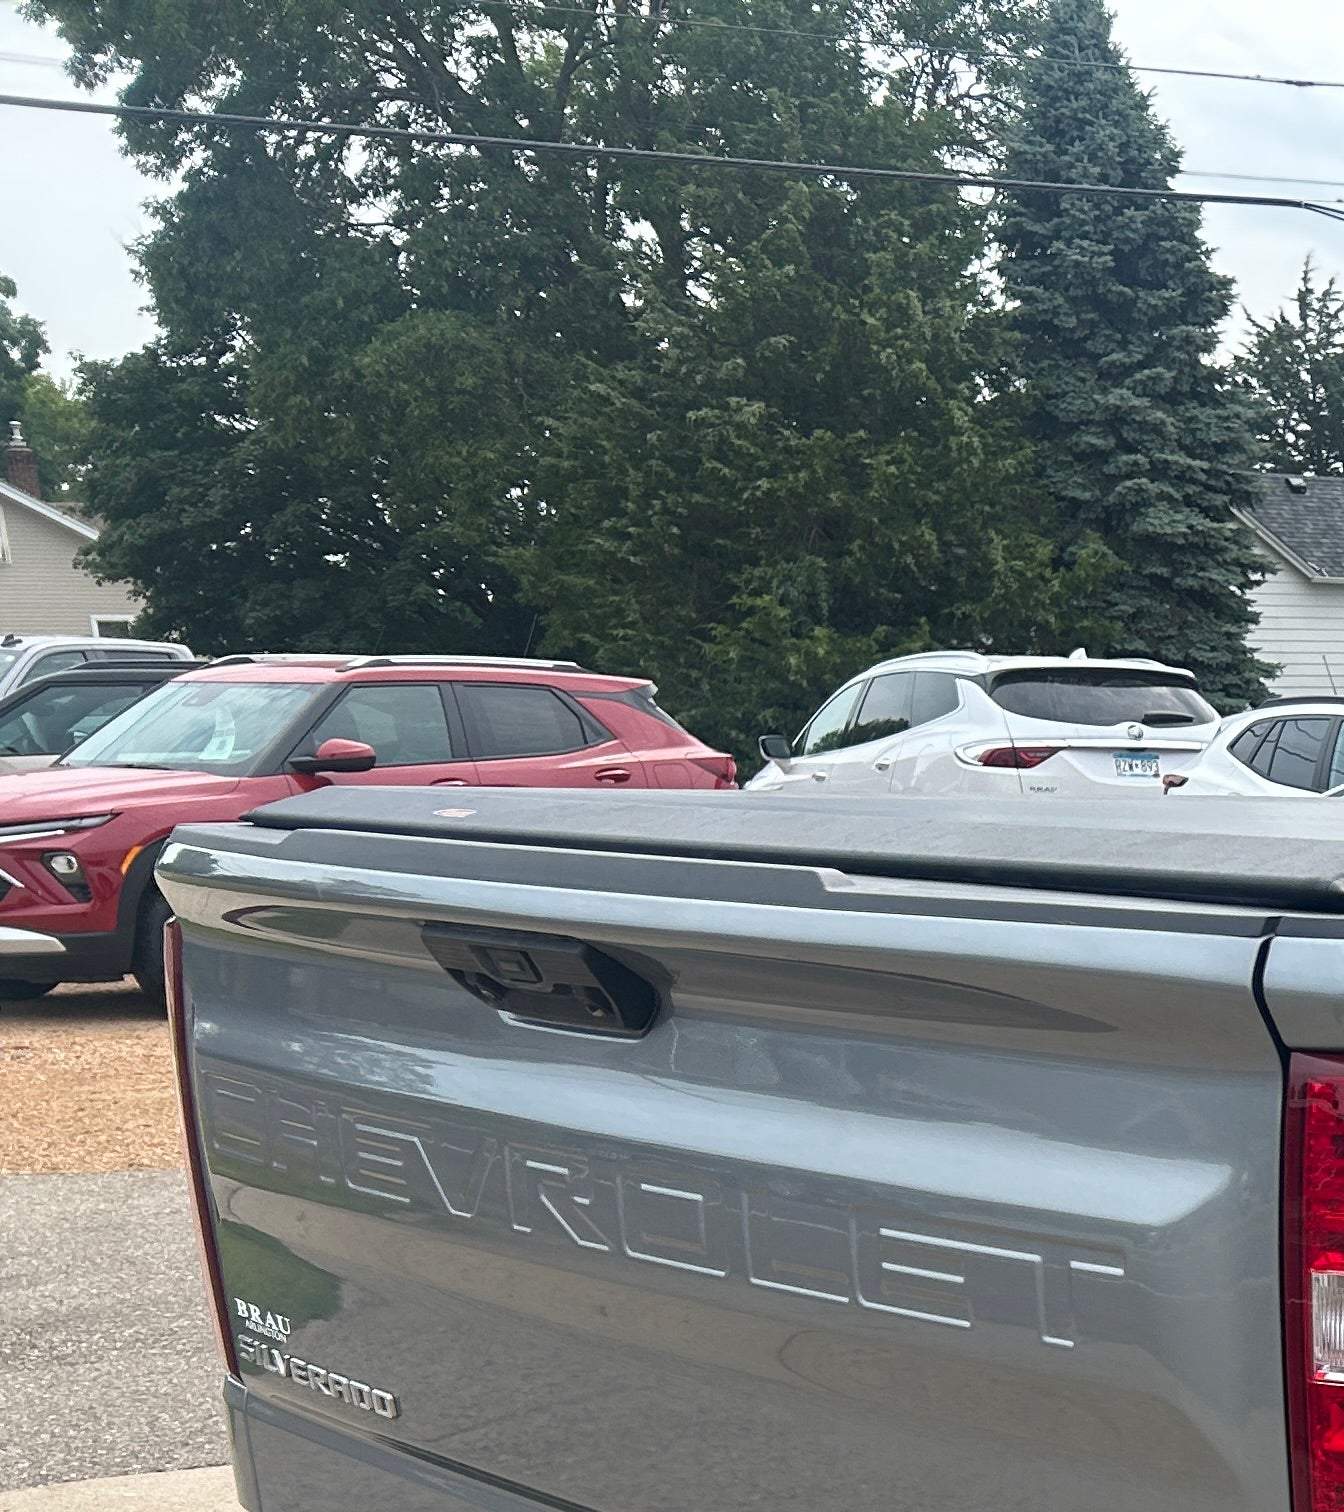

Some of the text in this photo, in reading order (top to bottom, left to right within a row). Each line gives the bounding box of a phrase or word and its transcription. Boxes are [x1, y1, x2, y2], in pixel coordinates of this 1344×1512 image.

[202, 1069, 1127, 1349] CHEVROLET
[233, 1297, 292, 1335] BRAU
[245, 1319, 287, 1344] ARLINGTON
[237, 1334, 398, 1419] SILVERADO
